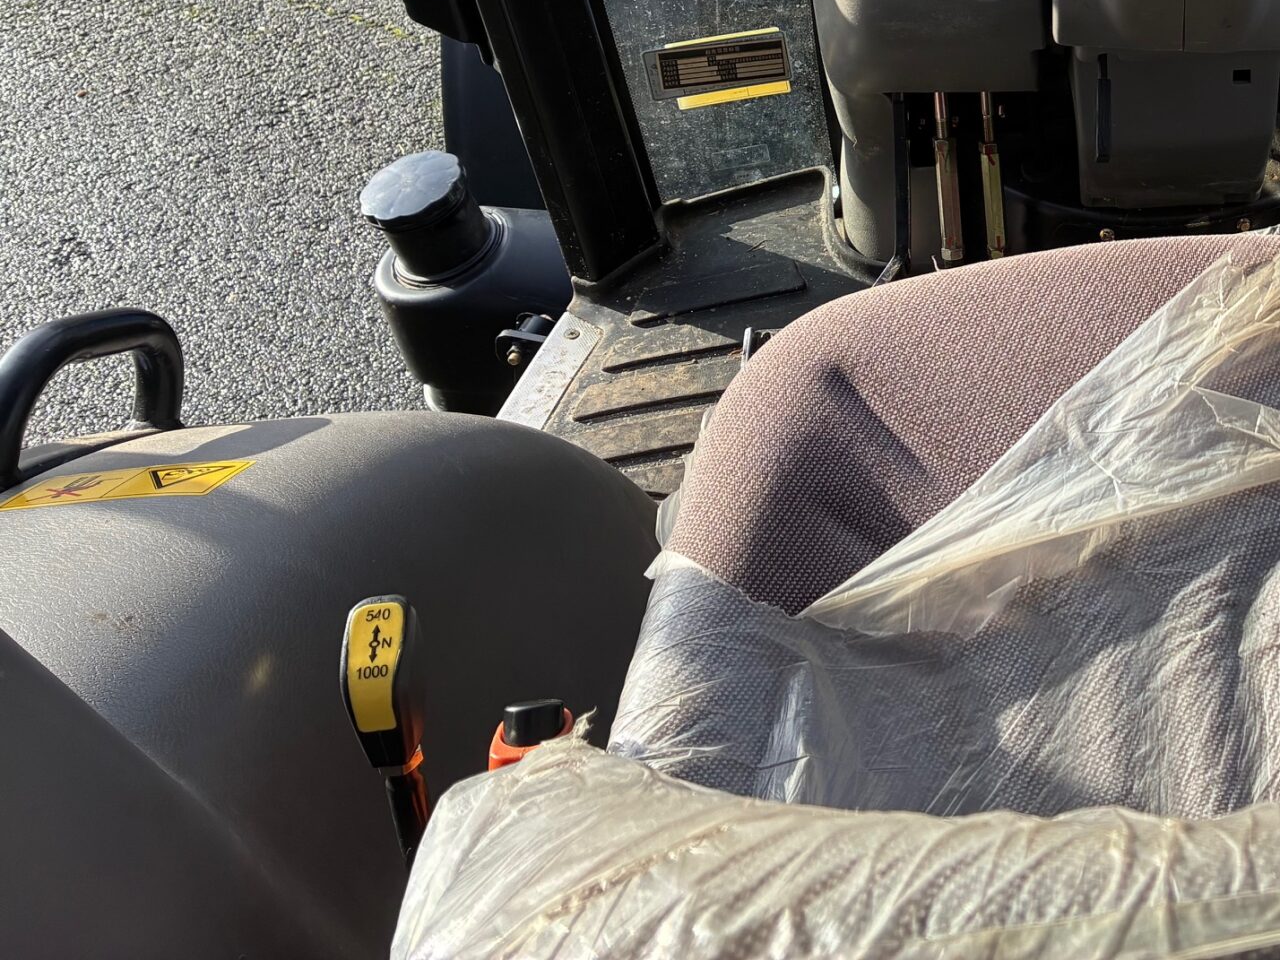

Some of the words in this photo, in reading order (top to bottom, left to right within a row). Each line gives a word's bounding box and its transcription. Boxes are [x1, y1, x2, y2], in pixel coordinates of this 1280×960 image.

[365, 608, 391, 622] 540
[382, 637, 393, 648] N
[356, 664, 389, 680] 1000
